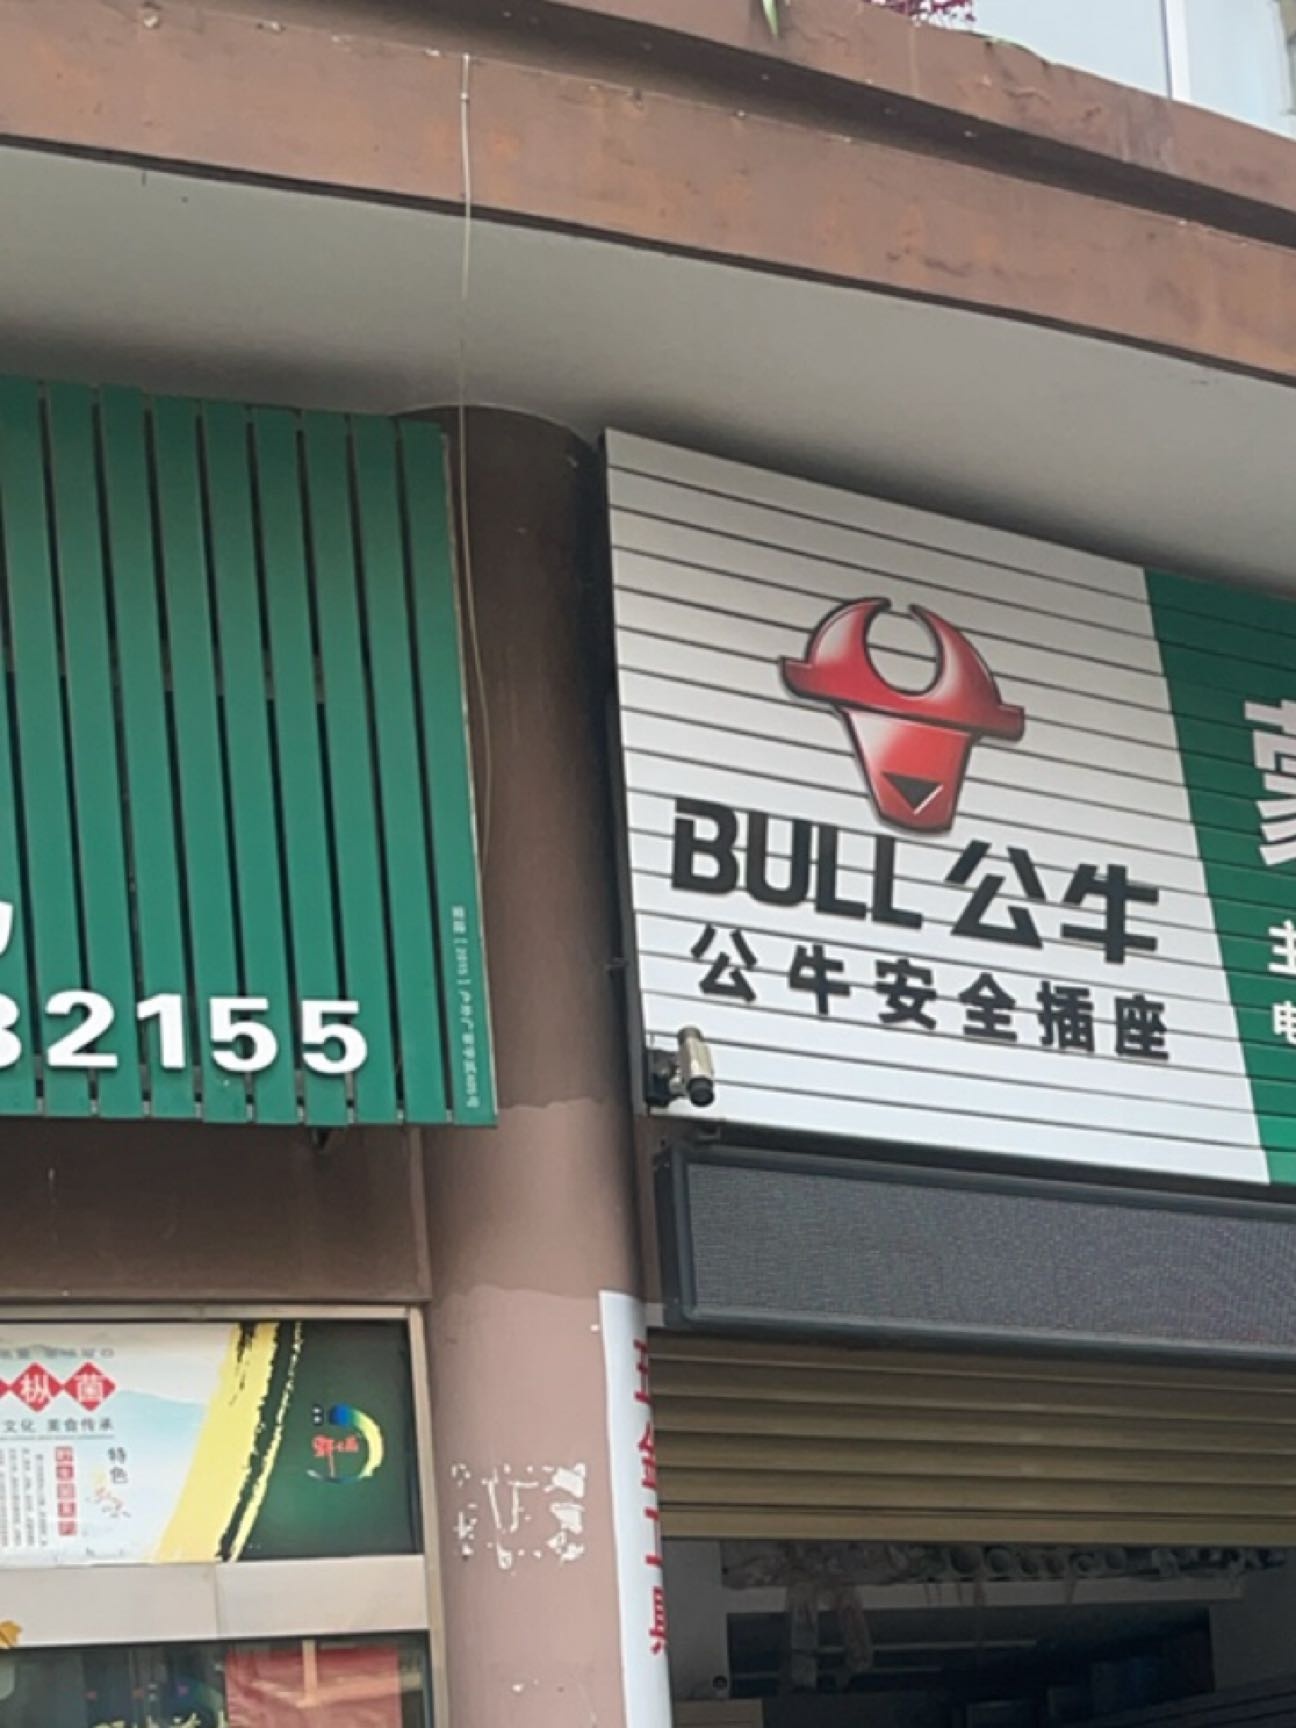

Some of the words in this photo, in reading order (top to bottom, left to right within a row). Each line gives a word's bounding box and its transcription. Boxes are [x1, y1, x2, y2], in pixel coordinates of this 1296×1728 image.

[672, 798, 923, 930] BULL
[944, 839, 1160, 965] 公牛
[690, 923, 1169, 1061] 公牛安全插座
